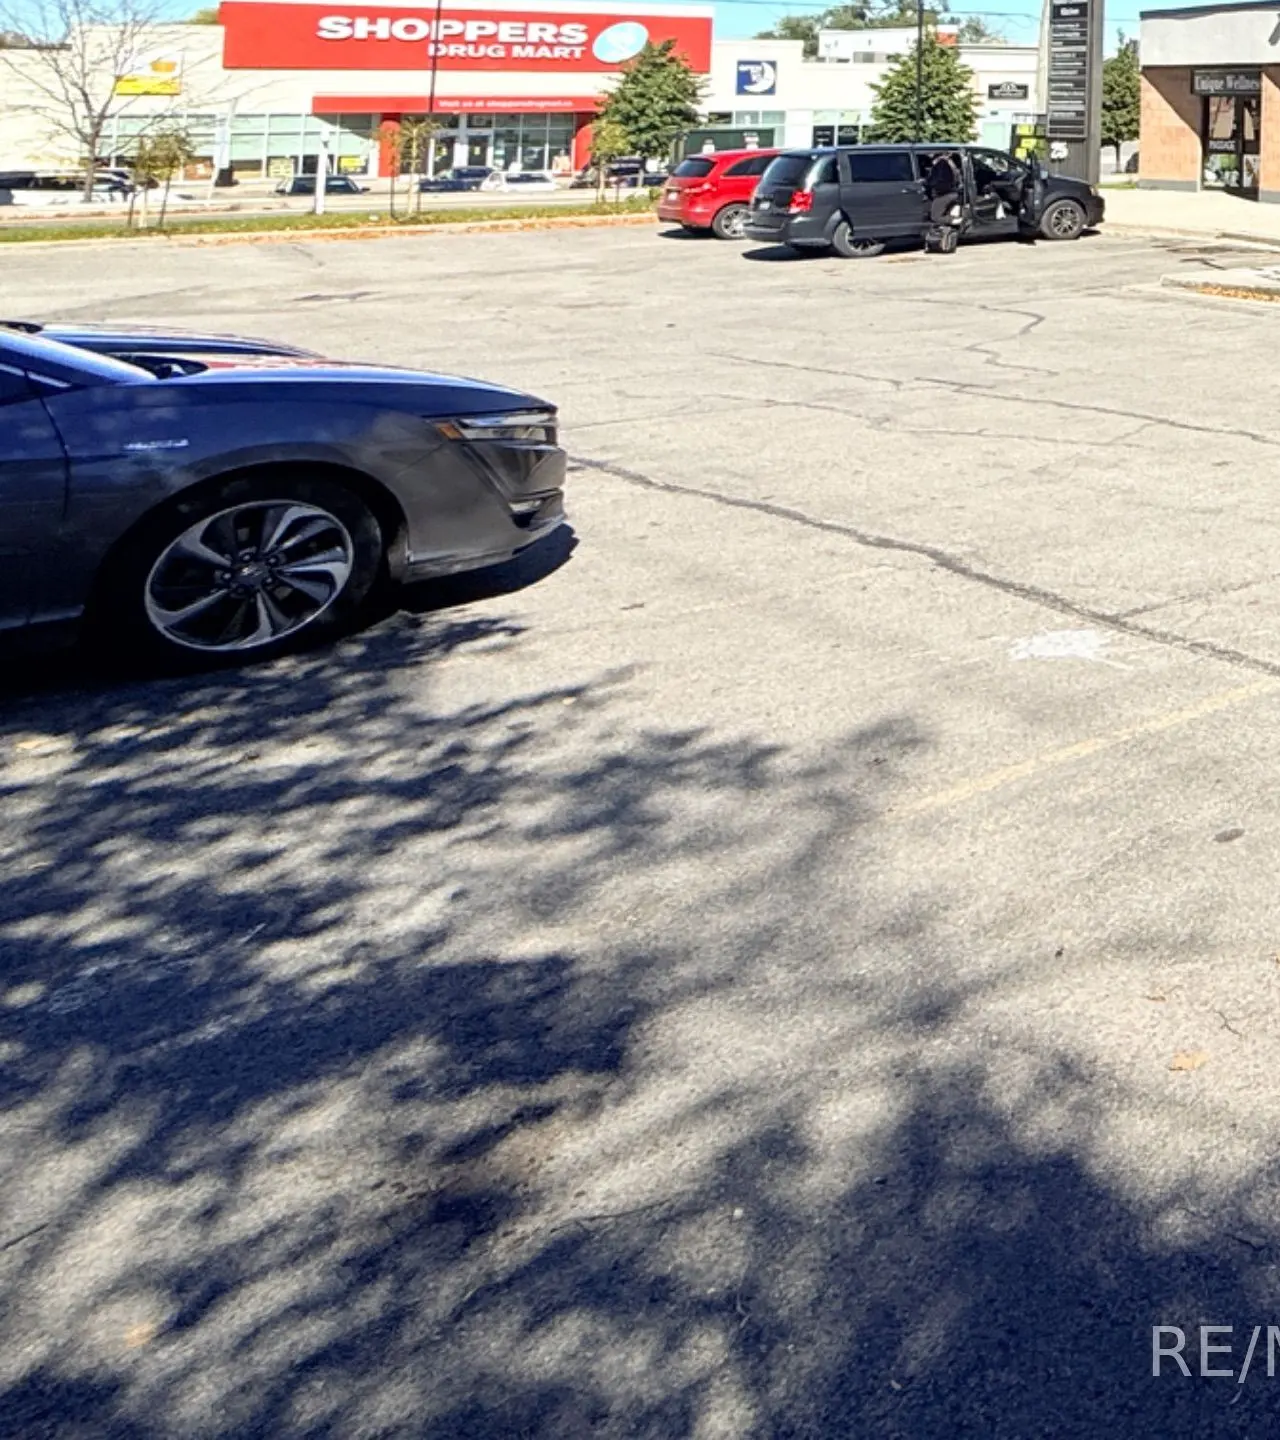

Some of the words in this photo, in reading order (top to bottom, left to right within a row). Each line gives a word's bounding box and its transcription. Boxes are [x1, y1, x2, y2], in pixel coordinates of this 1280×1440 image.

[316, 15, 589, 45] SHOPPERS
[428, 44, 505, 59] DRUG
[511, 45, 587, 60] MART
